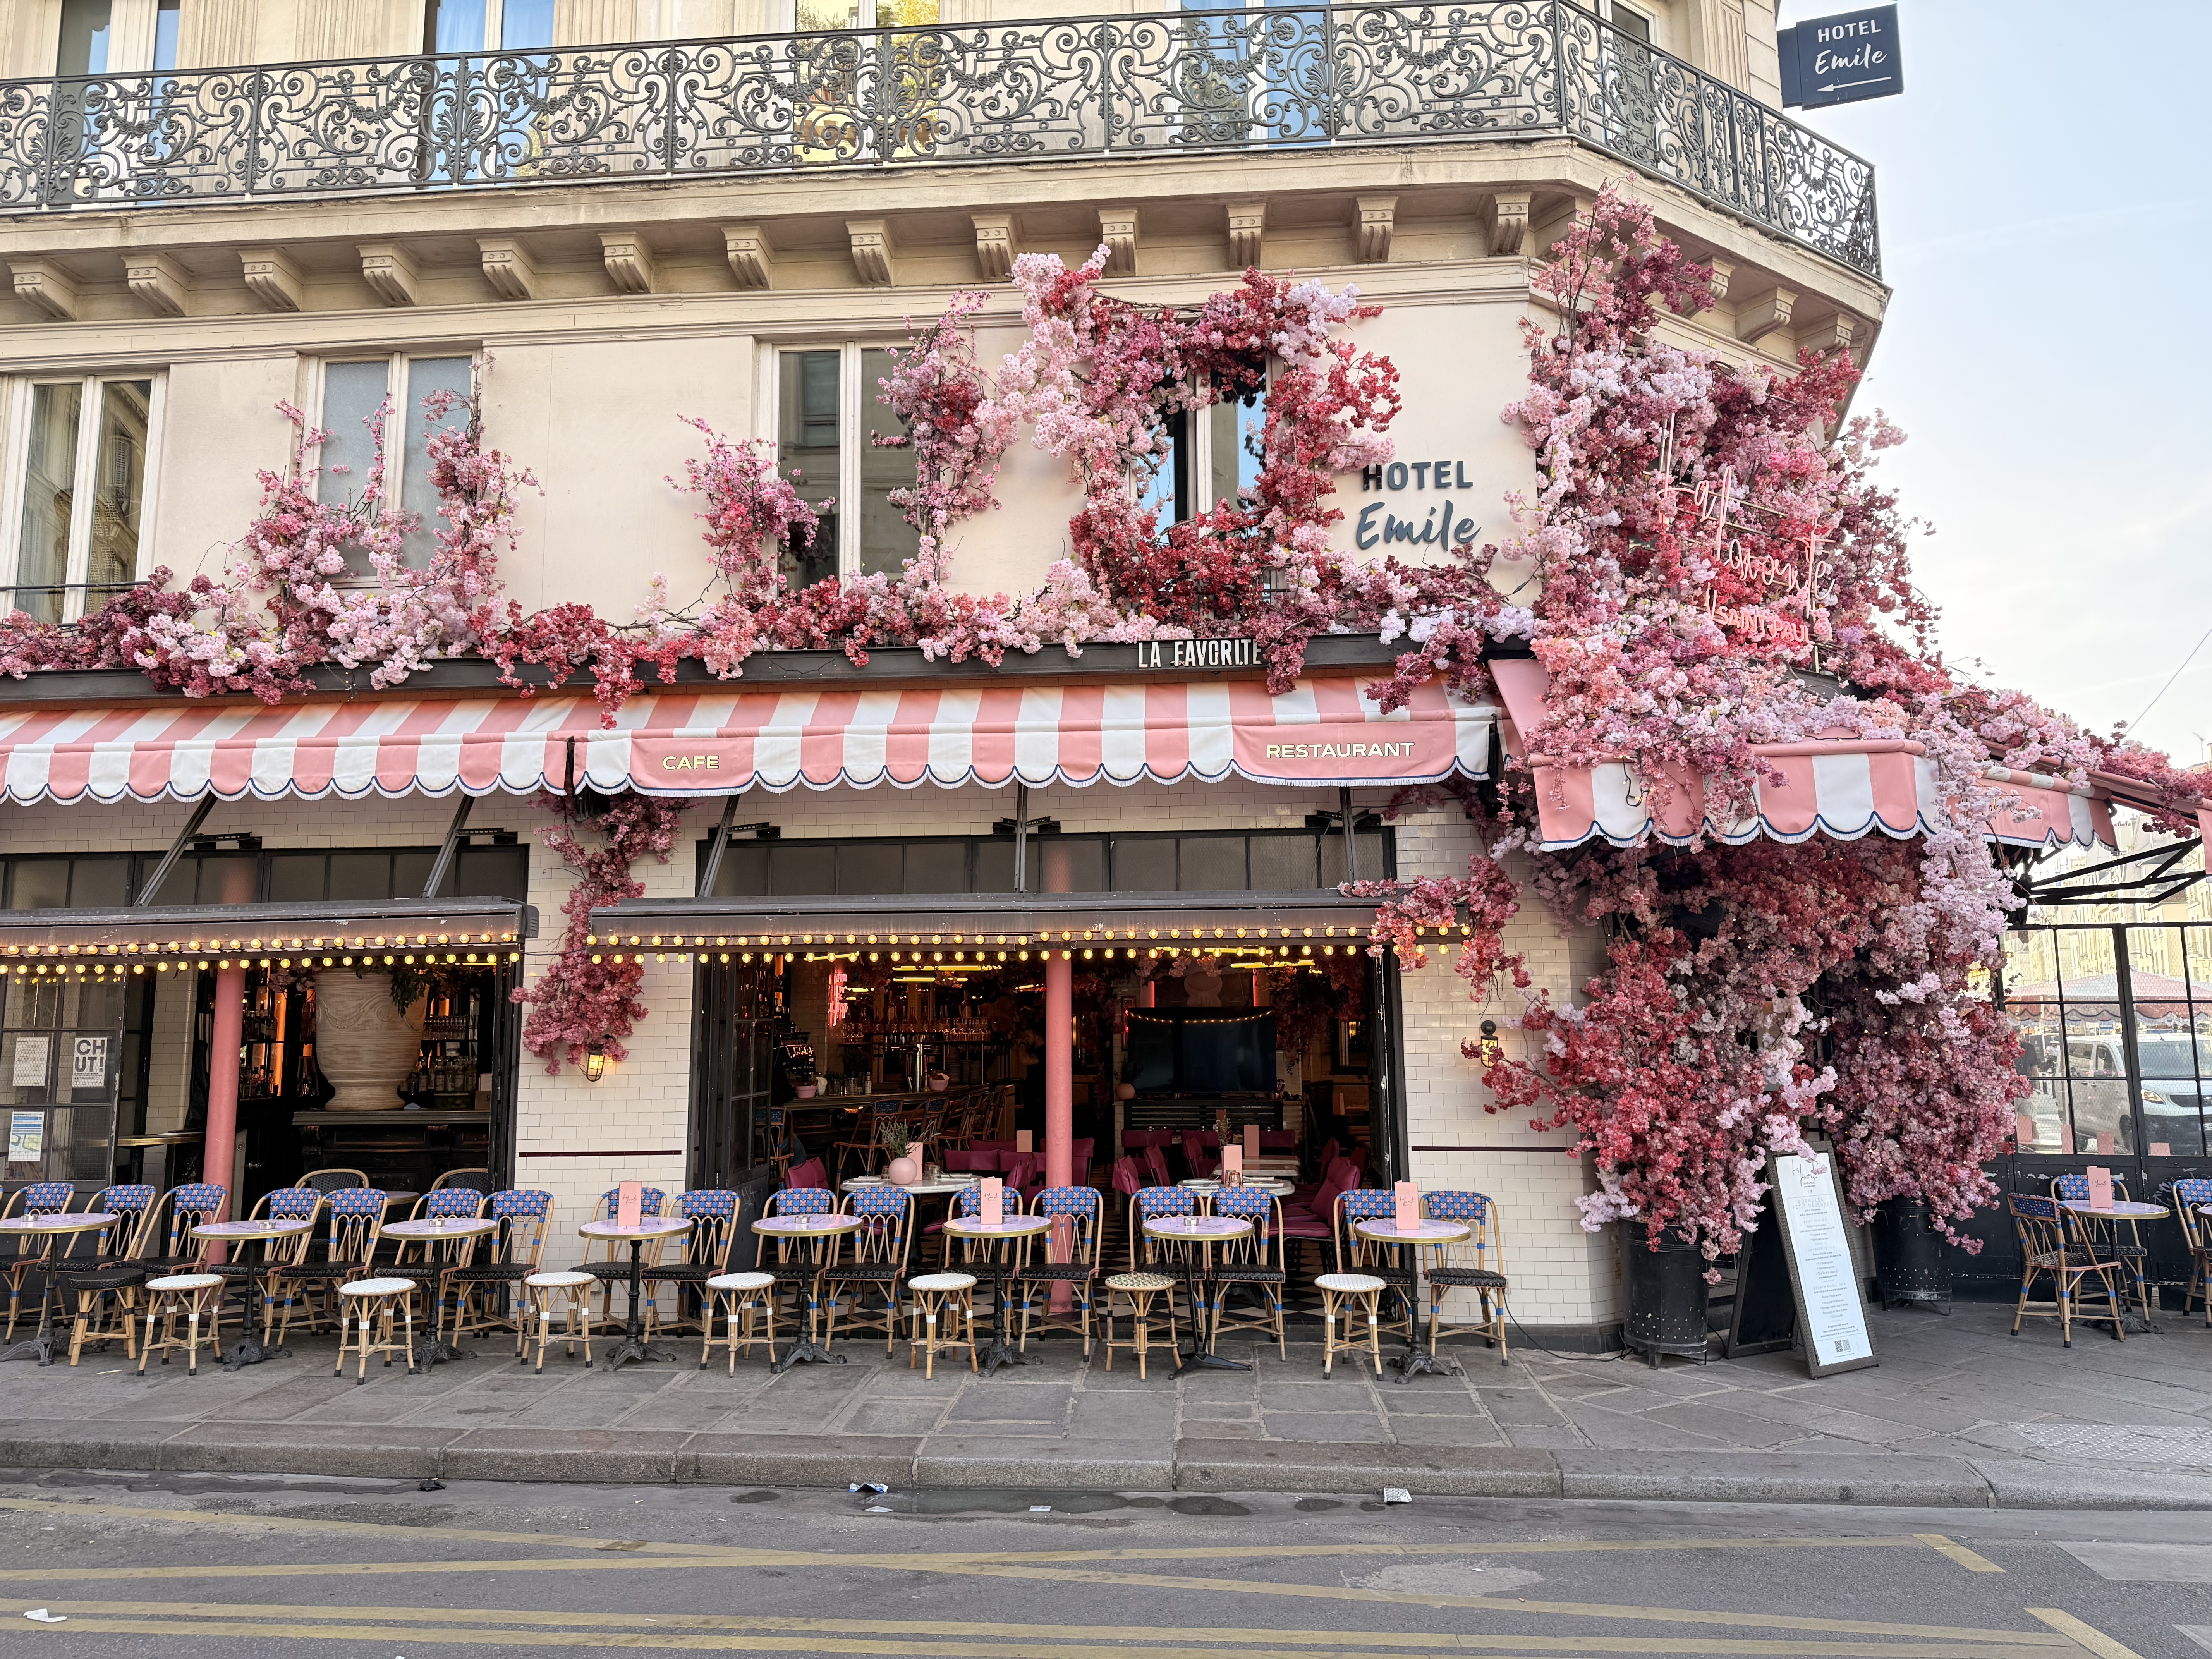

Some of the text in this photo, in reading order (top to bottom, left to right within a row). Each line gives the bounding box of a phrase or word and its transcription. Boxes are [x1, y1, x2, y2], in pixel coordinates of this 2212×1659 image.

[1818, 20, 1881, 43] HOTEL
[1815, 43, 1887, 75] Emile
[1362, 460, 1473, 491] HOTEL
[1356, 499, 1482, 551] Emile
[1138, 639, 1262, 668] LA FAVORITE
[662, 755, 720, 770] CAFE
[1266, 742, 1415, 759] RESTAURANT
[77, 1039, 105, 1055] CH
